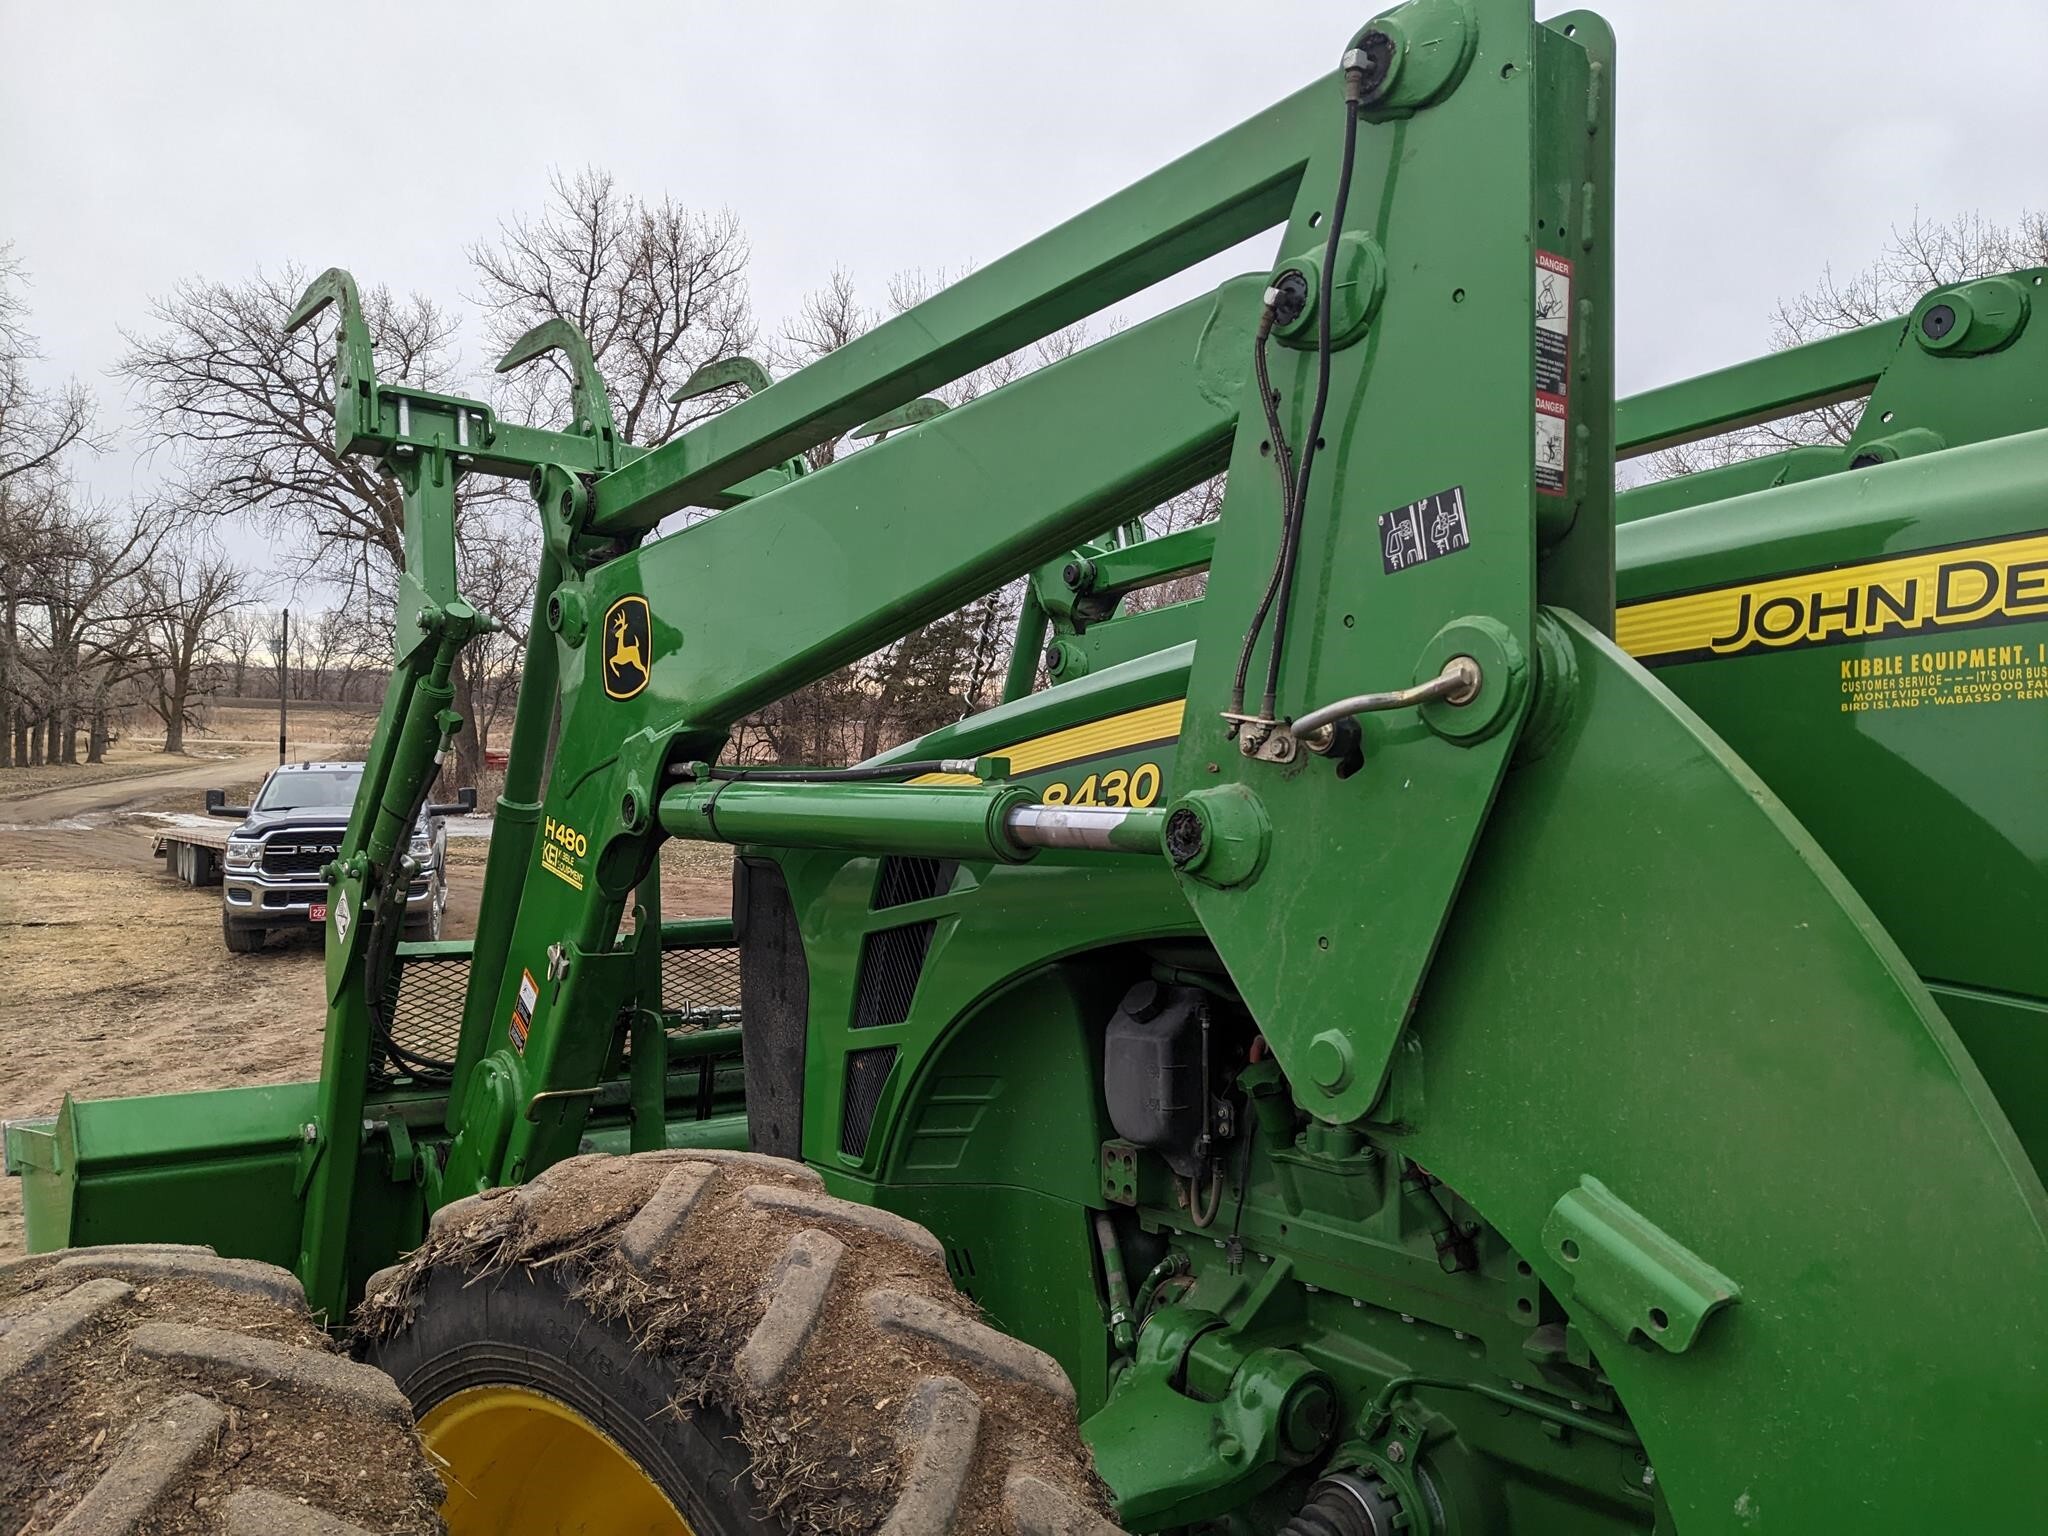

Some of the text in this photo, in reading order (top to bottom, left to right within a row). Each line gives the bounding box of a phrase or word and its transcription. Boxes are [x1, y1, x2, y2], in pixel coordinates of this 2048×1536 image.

[1540, 255, 1569, 274] DANGER
[1536, 397, 1565, 415] DANGER
[1711, 577, 1920, 649] JOHN
[1841, 656, 1902, 679] KIBBLE
[1841, 679, 1896, 693] CUSTOMER
[2000, 668, 2023, 681] OUR
[1852, 687, 1937, 702] MONTEVIDEO
[1954, 681, 2023, 694] REDWOOD
[1841, 702, 1869, 712] BIRD
[1873, 698, 1919, 709] ISLAND
[1934, 692, 2002, 705] WABASSO
[1041, 762, 1162, 808] 8430
[544, 815, 587, 858] H480
